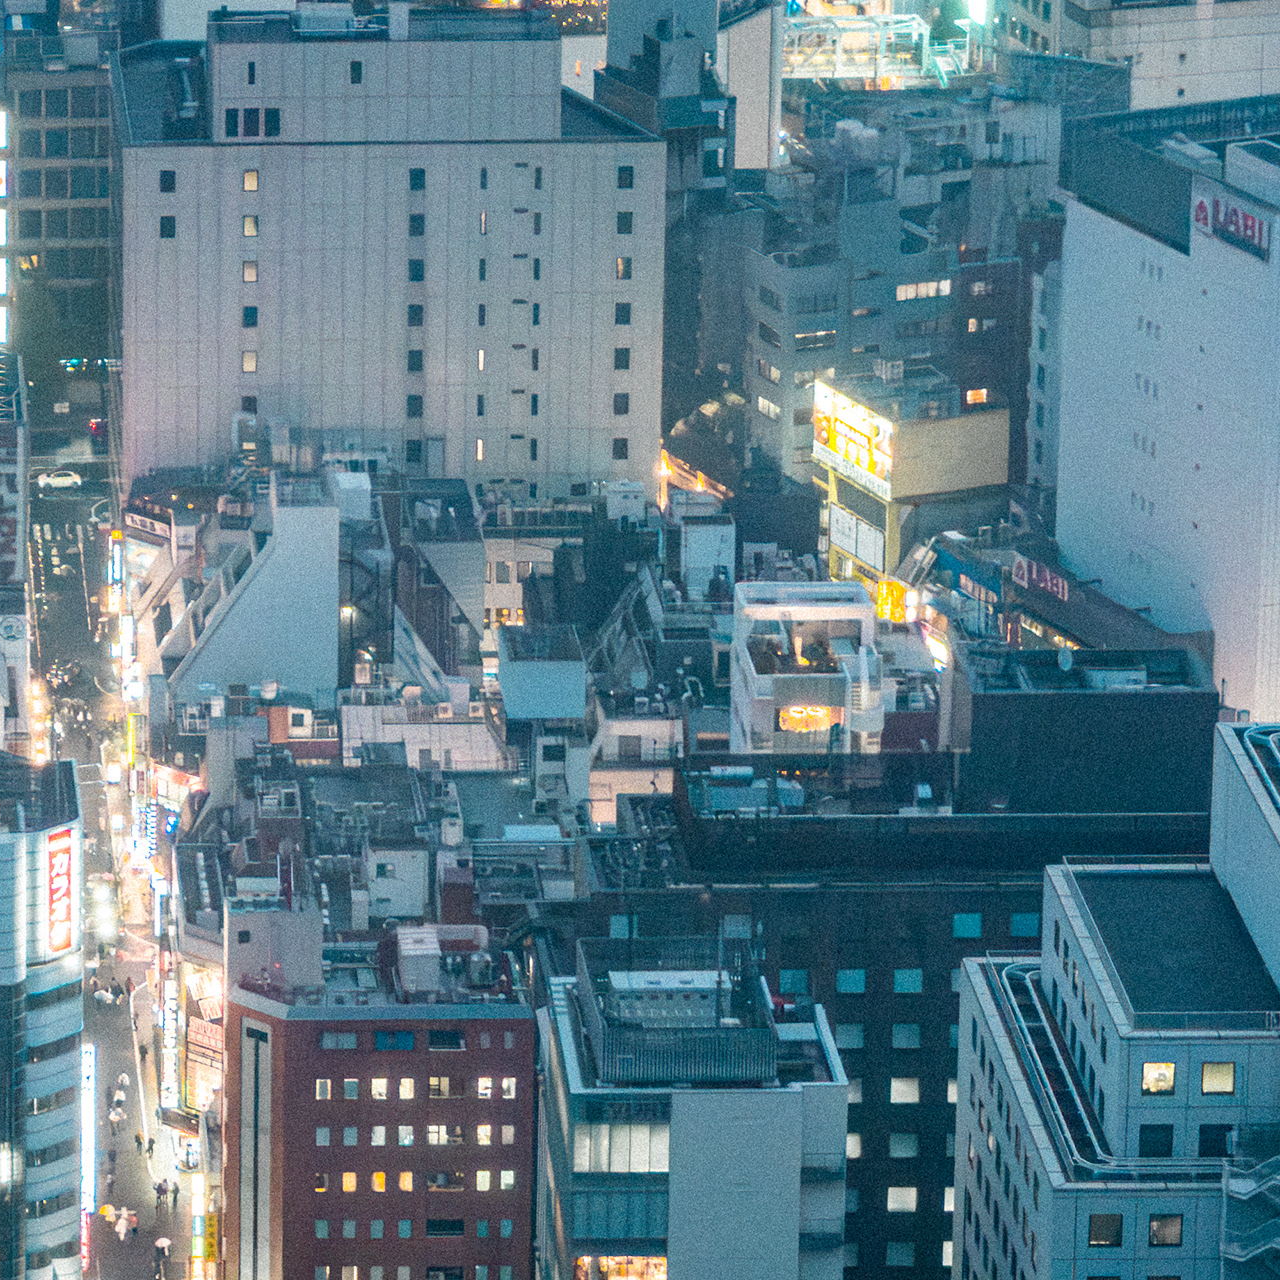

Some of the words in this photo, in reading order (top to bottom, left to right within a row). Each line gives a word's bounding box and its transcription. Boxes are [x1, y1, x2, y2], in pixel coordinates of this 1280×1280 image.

[1212, 196, 1264, 248] LABI
[1027, 559, 1068, 602] LABI
[51, 852, 70, 946] カラオケ
